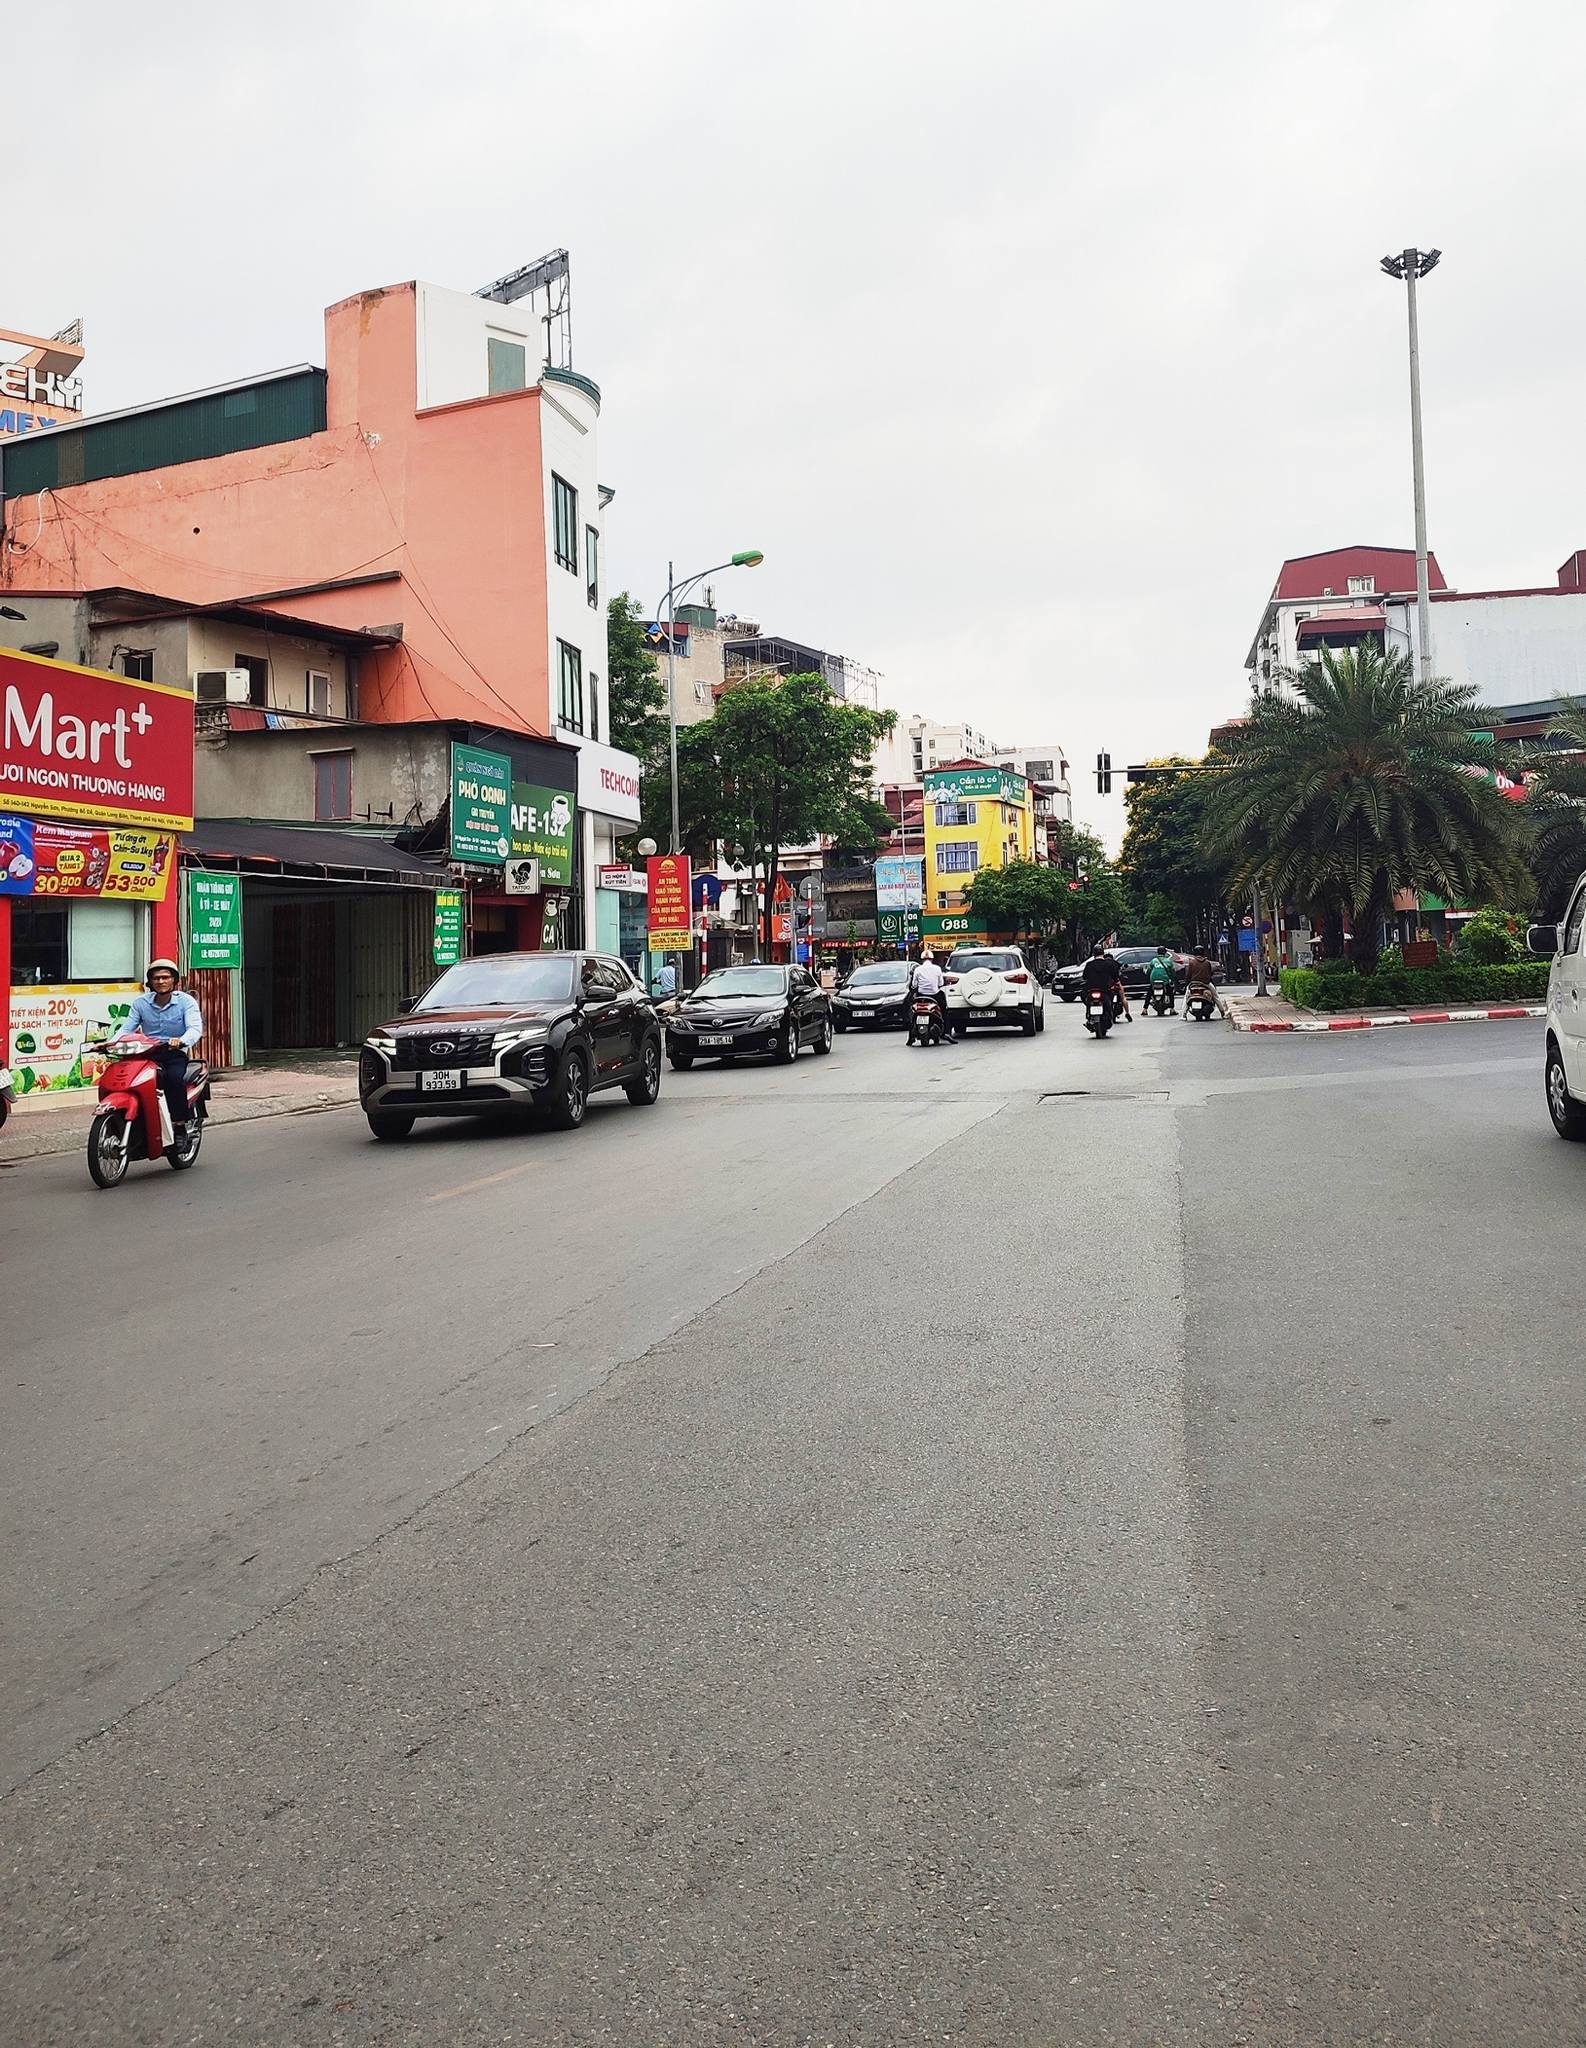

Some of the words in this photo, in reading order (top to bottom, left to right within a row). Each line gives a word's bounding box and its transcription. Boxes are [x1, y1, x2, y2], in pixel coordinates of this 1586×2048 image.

[27, 768, 68, 788] NGON
[71, 773, 126, 798] THƯỢNG
[458, 778, 479, 800] PHỞ
[941, 918, 969, 931] F88
[48, 999, 78, 1016] 20%
[433, 1071, 450, 1080] 30H
[425, 1080, 457, 1090] 933.59
